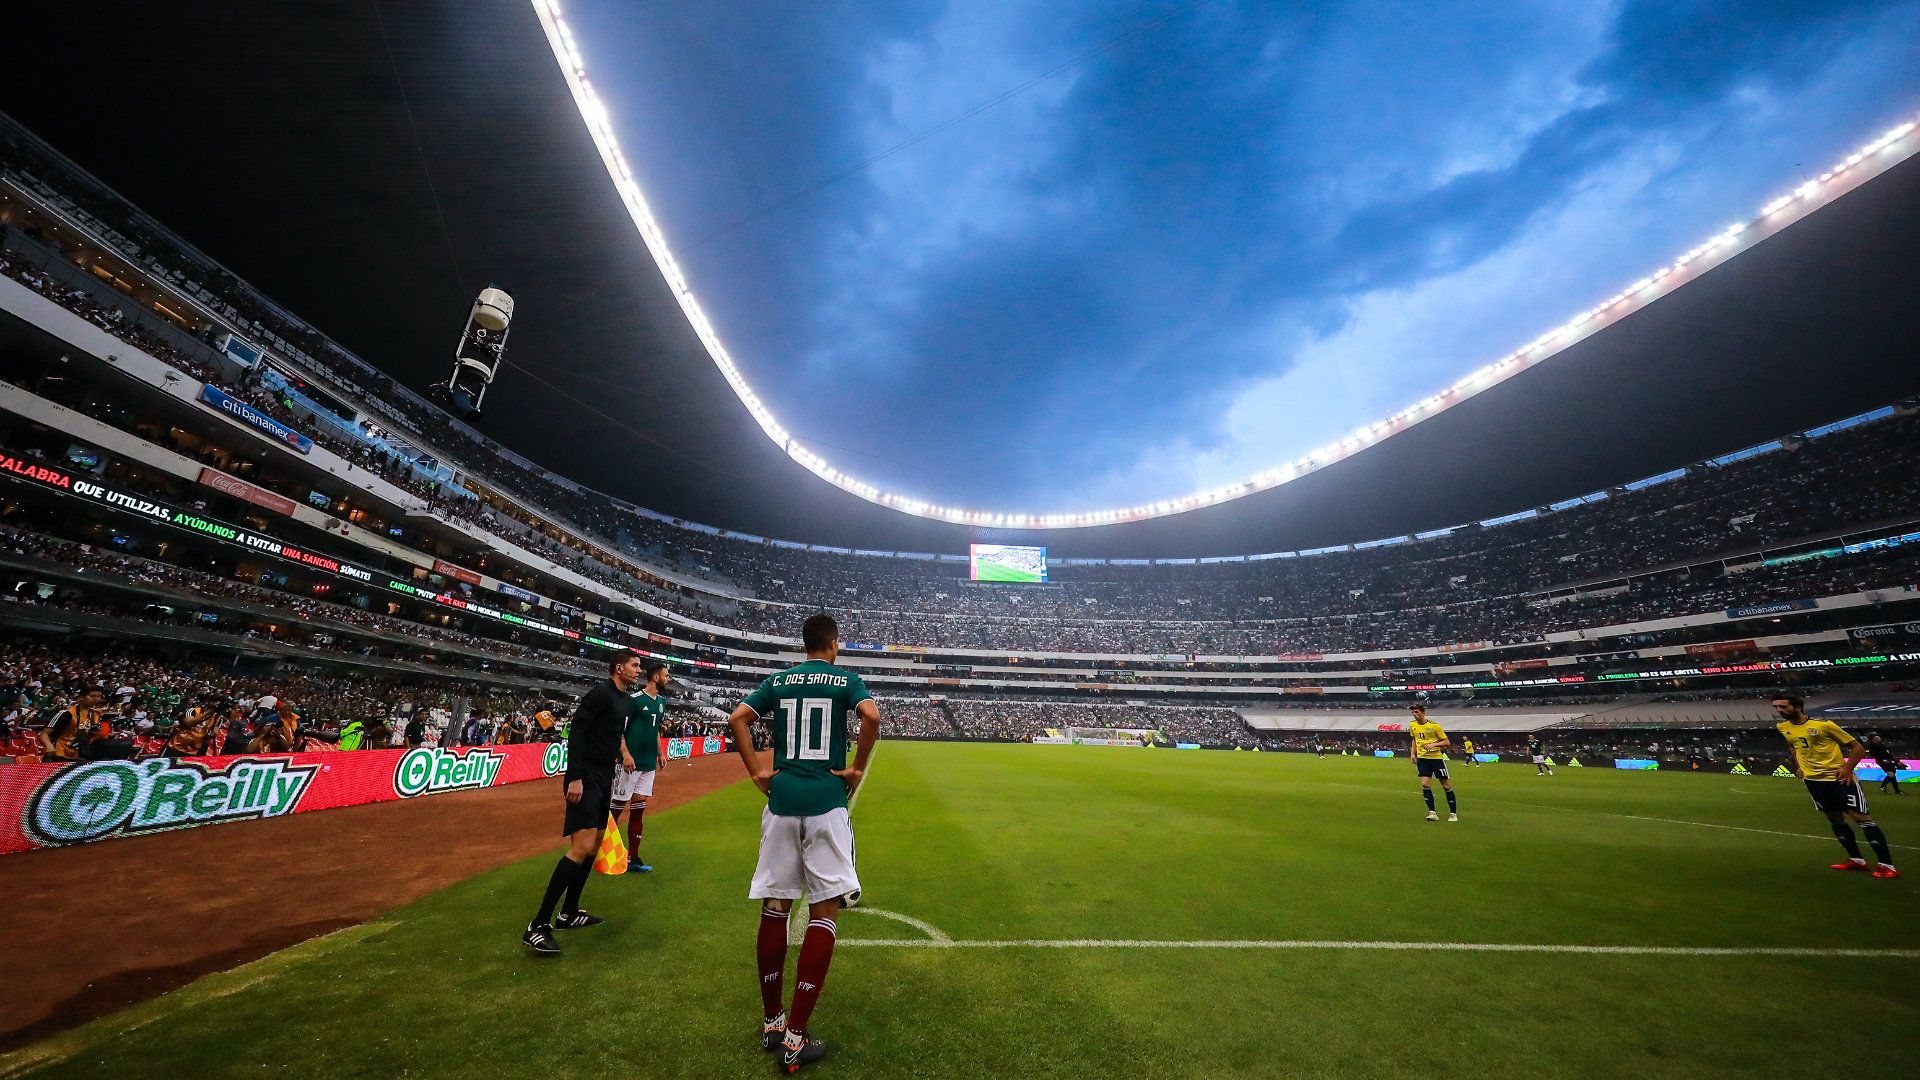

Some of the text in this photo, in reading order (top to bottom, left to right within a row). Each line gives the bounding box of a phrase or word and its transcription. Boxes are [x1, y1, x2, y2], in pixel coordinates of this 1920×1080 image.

[222, 399, 289, 441] citibanamex
[74, 481, 105, 499] QUE
[106, 491, 171, 522] UTILIZAS,
[174, 513, 236, 540] AYÚDANOS
[236, 533, 245, 542] A
[247, 536, 281, 554] EVITAR
[281, 546, 301, 560] UNA
[301, 552, 339, 573] SANCIÓN,
[389, 580, 416, 594] CANTAR
[435, 594, 445, 603] NO
[1738, 603, 1792, 616] citibanamex
[1853, 628, 1896, 639] Corona
[1605, 672, 1639, 680] PROBLEMA
[1788, 659, 1834, 668] UTILIZAS,
[1835, 656, 1888, 665] AYÚDANOS
[785, 673, 806, 685] DOS
[806, 673, 848, 687] SANTOS
[651, 713, 657, 727] 7
[780, 697, 833, 760] 10
[1798, 736, 1810, 749] 3
[400, 749, 499, 793] O'Reilly
[46, 759, 304, 834] O'Reilly
[1847, 794, 1857, 807] 3
